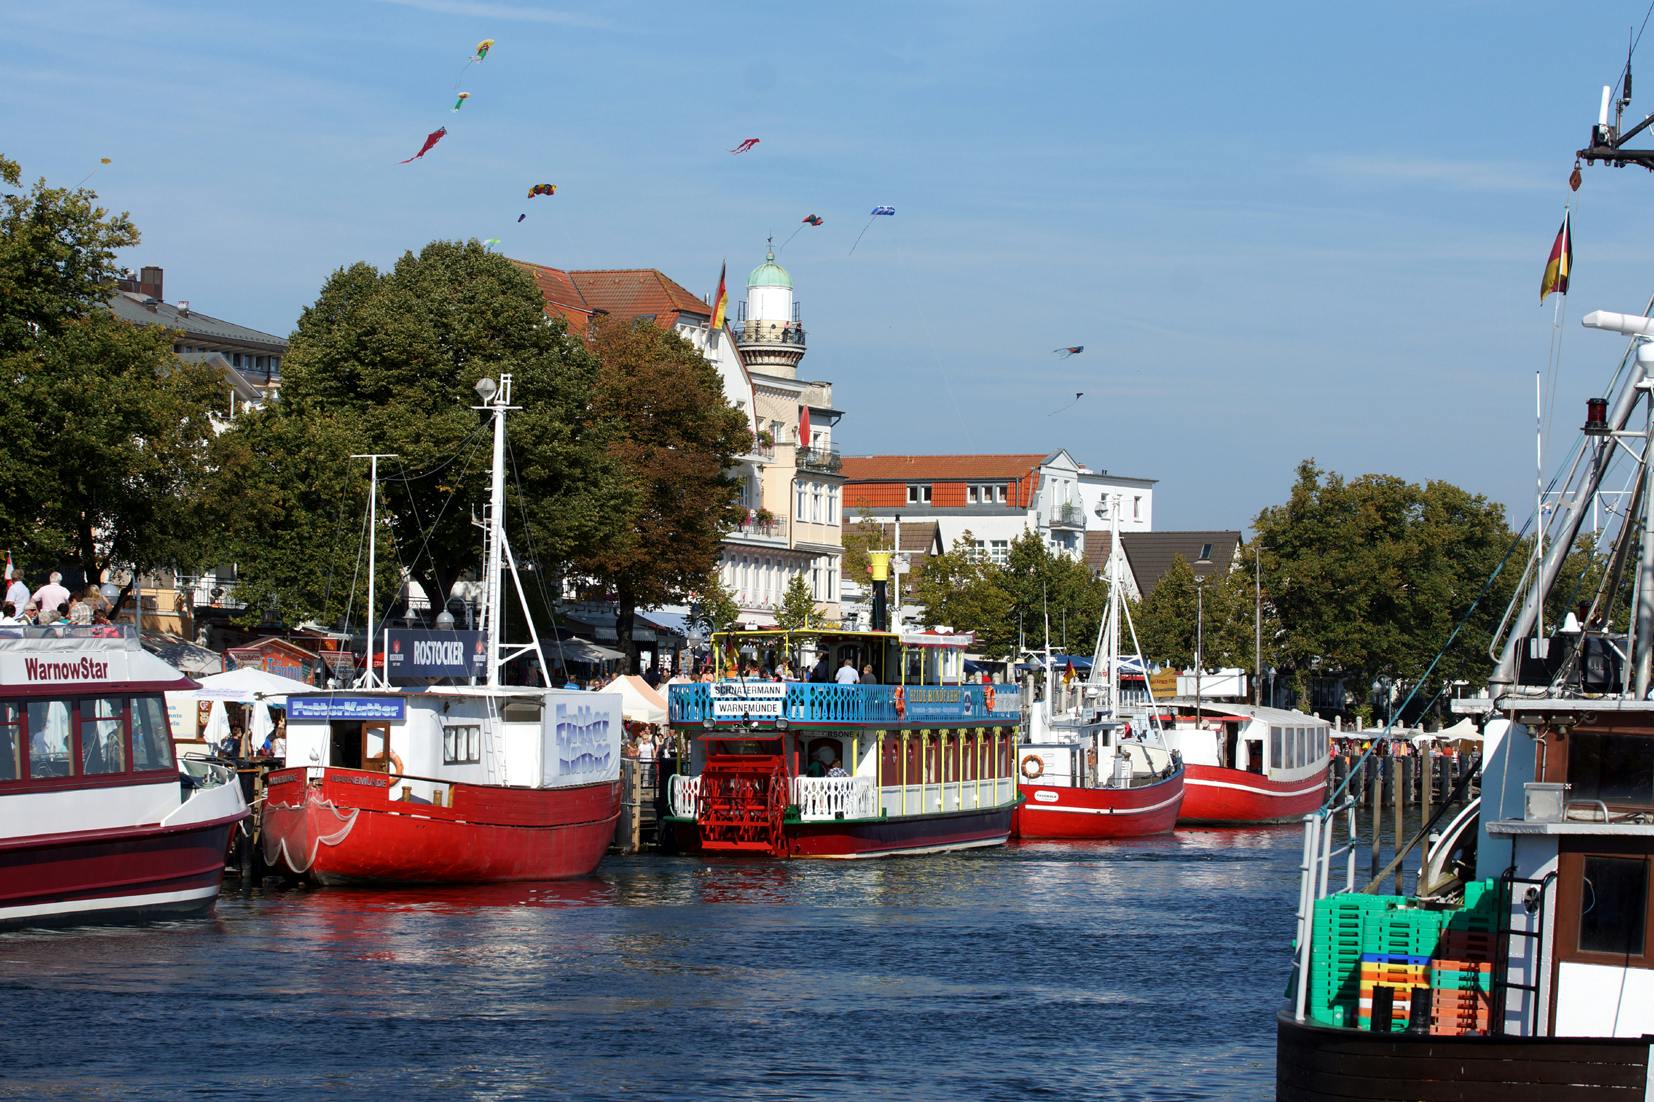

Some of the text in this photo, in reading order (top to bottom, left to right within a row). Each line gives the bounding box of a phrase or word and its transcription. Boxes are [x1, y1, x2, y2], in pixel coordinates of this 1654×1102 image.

[414, 641, 464, 666] ROSTOCKER
[25, 656, 109, 681] WarnowStar
[719, 702, 778, 713] WARNEMÜNDE
